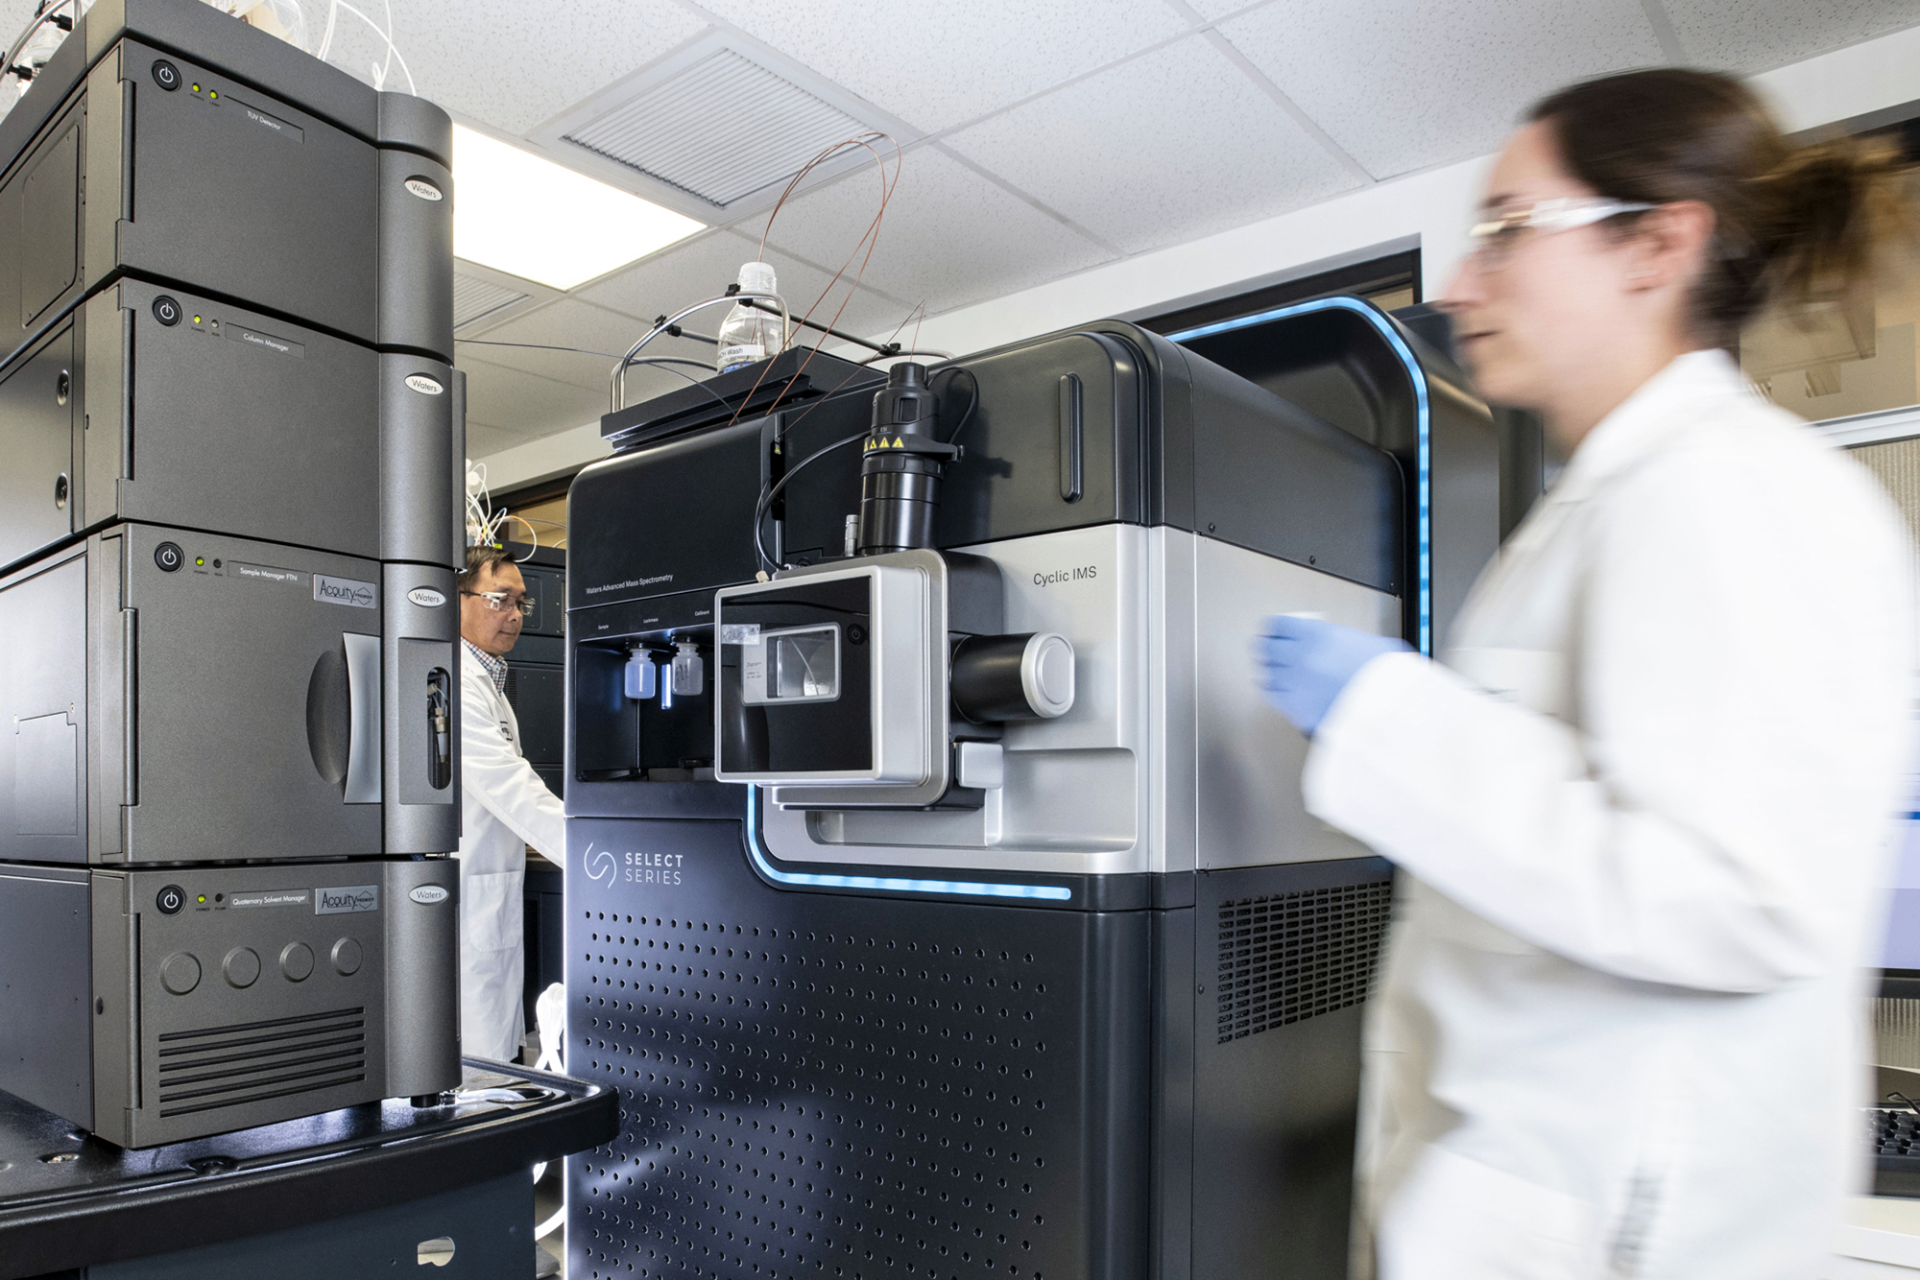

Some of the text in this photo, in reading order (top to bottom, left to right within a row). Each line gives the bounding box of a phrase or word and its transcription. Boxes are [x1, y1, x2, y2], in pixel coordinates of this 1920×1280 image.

[247, 110, 281, 130] TUV Detector
[411, 182, 437, 199] Waters
[243, 333, 289, 352] Column Manager
[727, 347, 743, 356] Wash
[411, 378, 437, 393] Waters
[240, 567, 298, 581] Sample Manager FTN
[1033, 565, 1097, 588] Cyclic IMS
[319, 579, 355, 603] Acquity
[586, 574, 673, 594] Waters Advanced Mass Spectrometry
[414, 592, 440, 603] Waters
[625, 852, 683, 868] SELECT
[625, 868, 681, 885] SERIES
[232, 894, 306, 906] Quaternary Solvent Manager
[321, 891, 357, 910] Acquity
[416, 890, 442, 899] Waters
